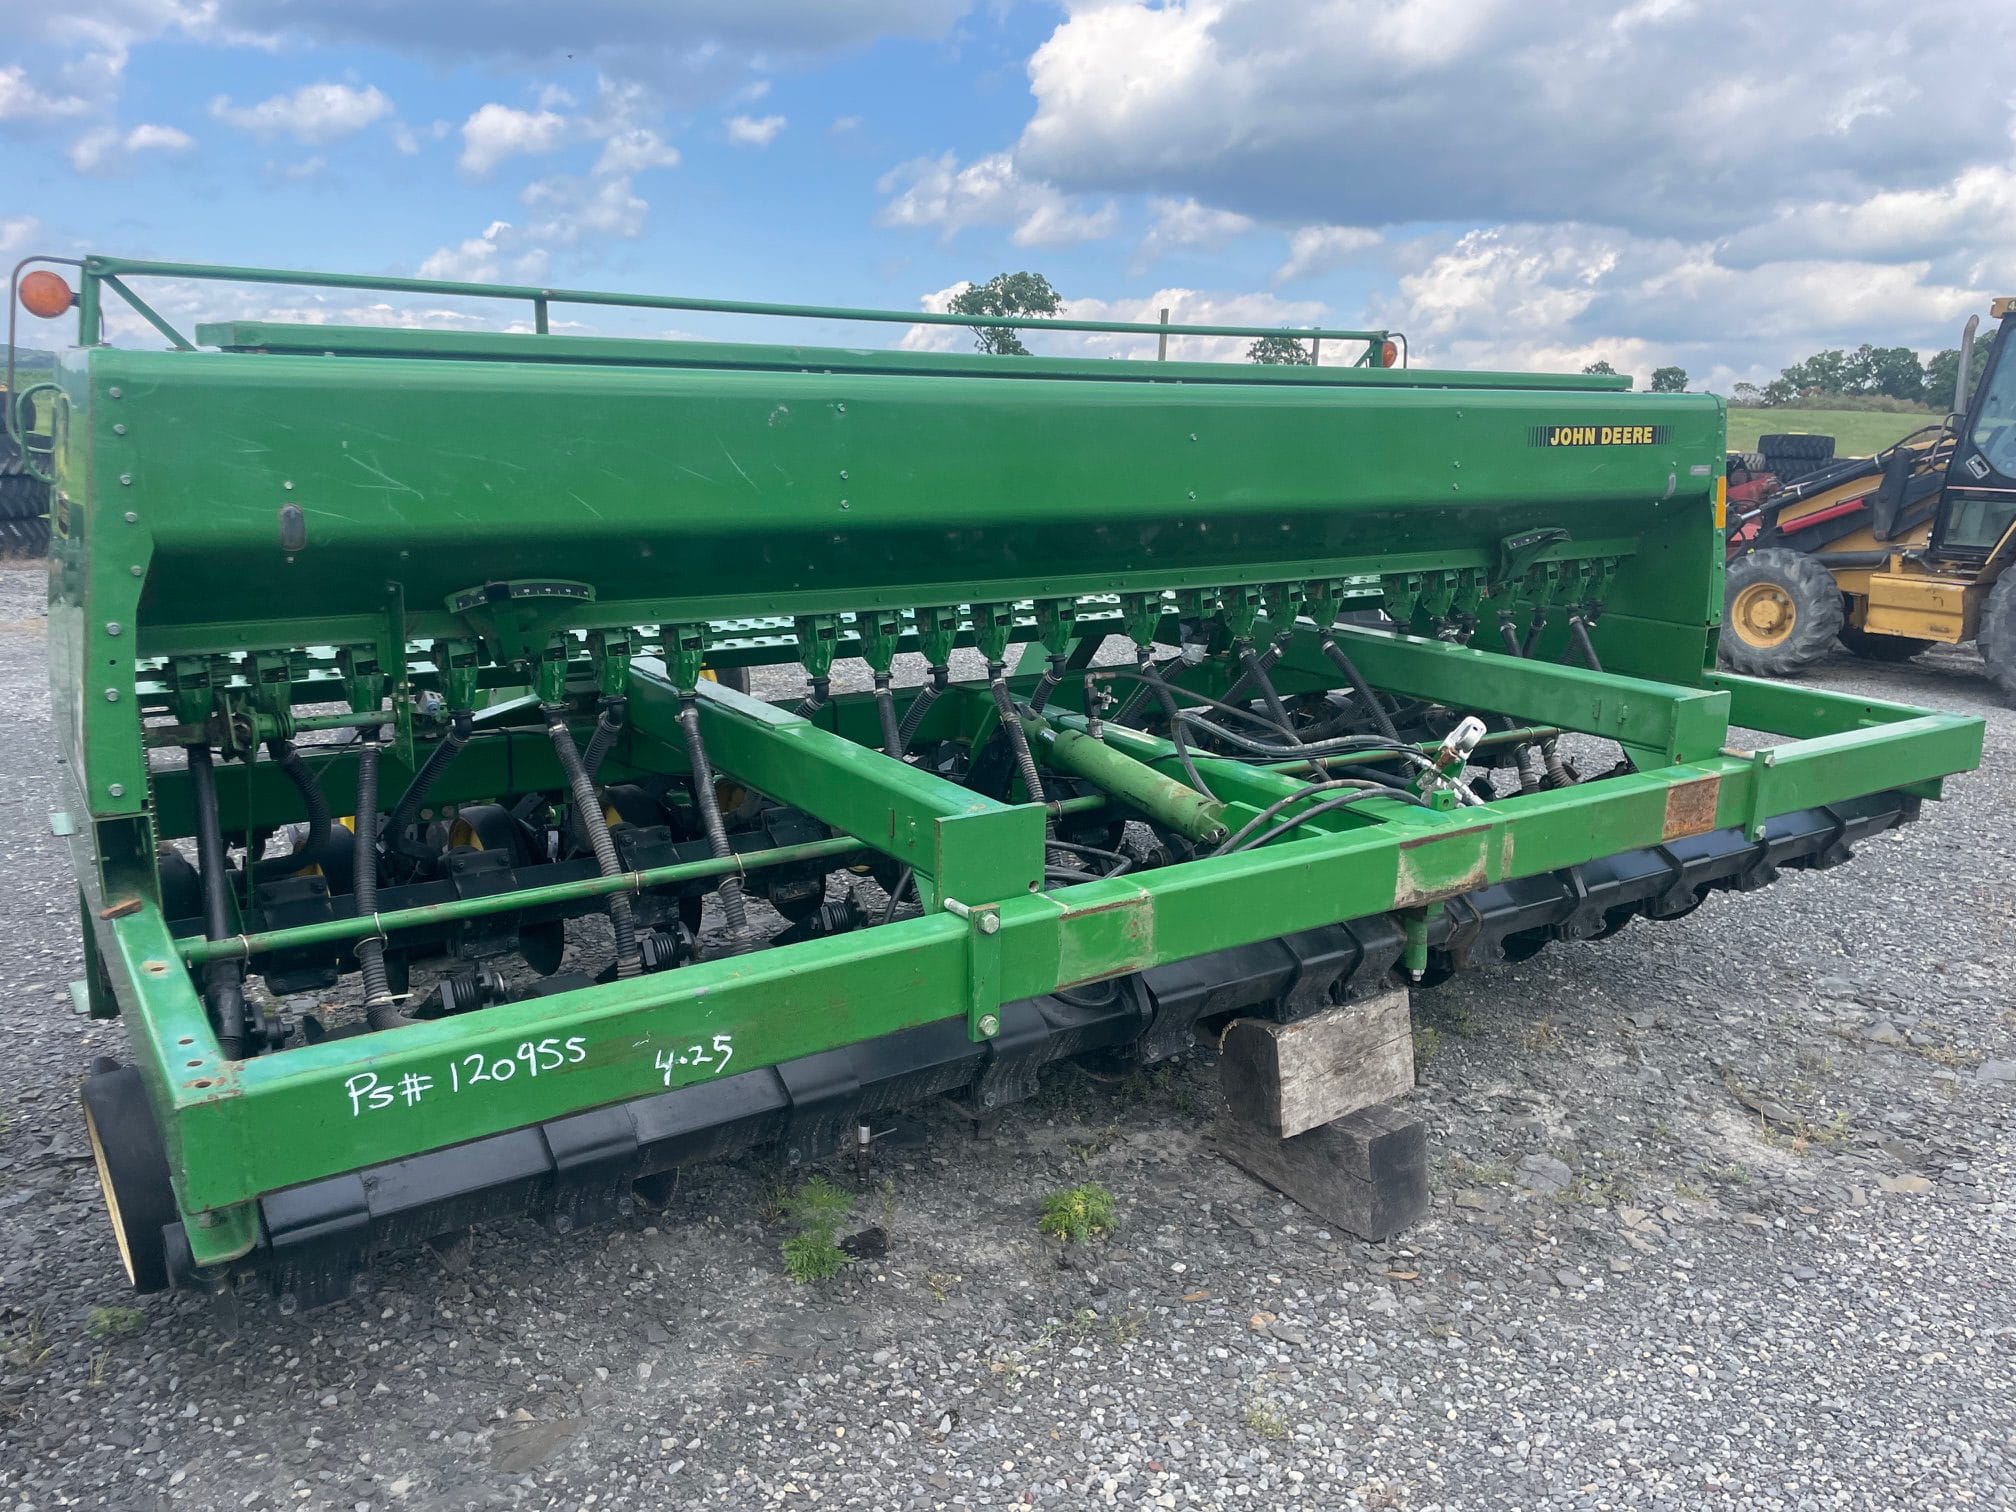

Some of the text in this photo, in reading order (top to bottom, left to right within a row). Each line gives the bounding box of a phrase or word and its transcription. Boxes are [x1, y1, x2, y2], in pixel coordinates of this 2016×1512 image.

[1550, 426, 1653, 446] JOHN DEERE
[450, 1037, 587, 1094] 120955
